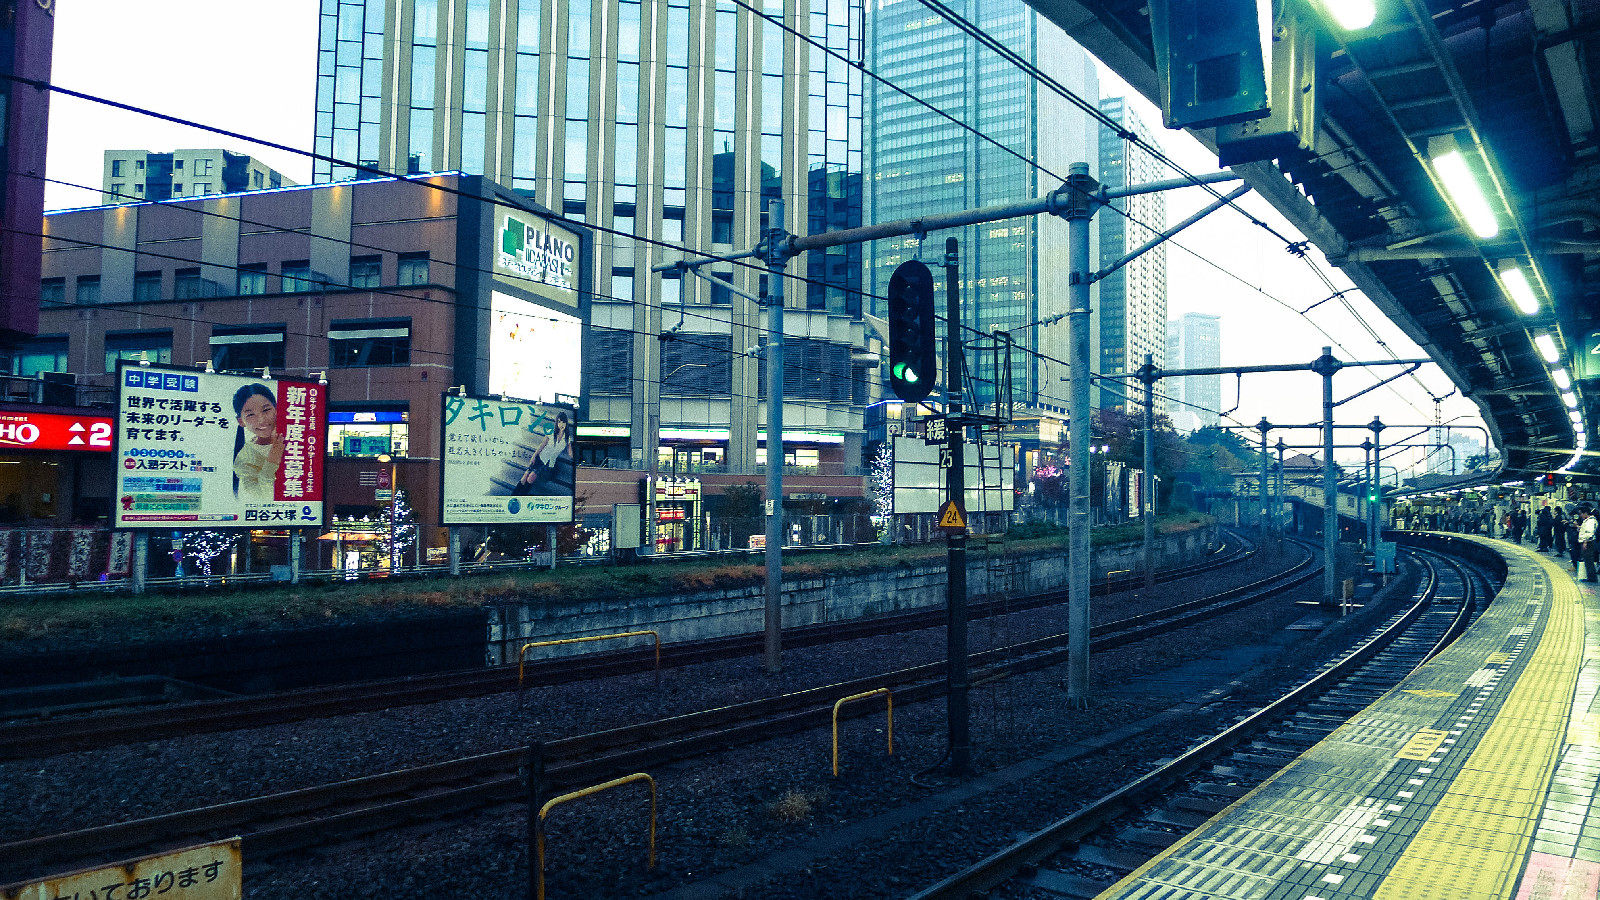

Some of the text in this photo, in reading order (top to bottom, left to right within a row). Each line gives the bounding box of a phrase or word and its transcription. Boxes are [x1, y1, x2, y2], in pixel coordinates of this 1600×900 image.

[526, 225, 575, 263] PLANO
[128, 375, 196, 389] 中学受験
[127, 396, 222, 414] 世界で活躍する
[89, 422, 111, 446] 2
[126, 428, 184, 442] 育てます。
[926, 419, 945, 441] 緩
[283, 386, 307, 498] 新年度生募集
[941, 450, 952, 468] 25
[245, 509, 297, 521] 四谷大塚
[946, 511, 957, 524] 24
[53, 859, 225, 900] いております
